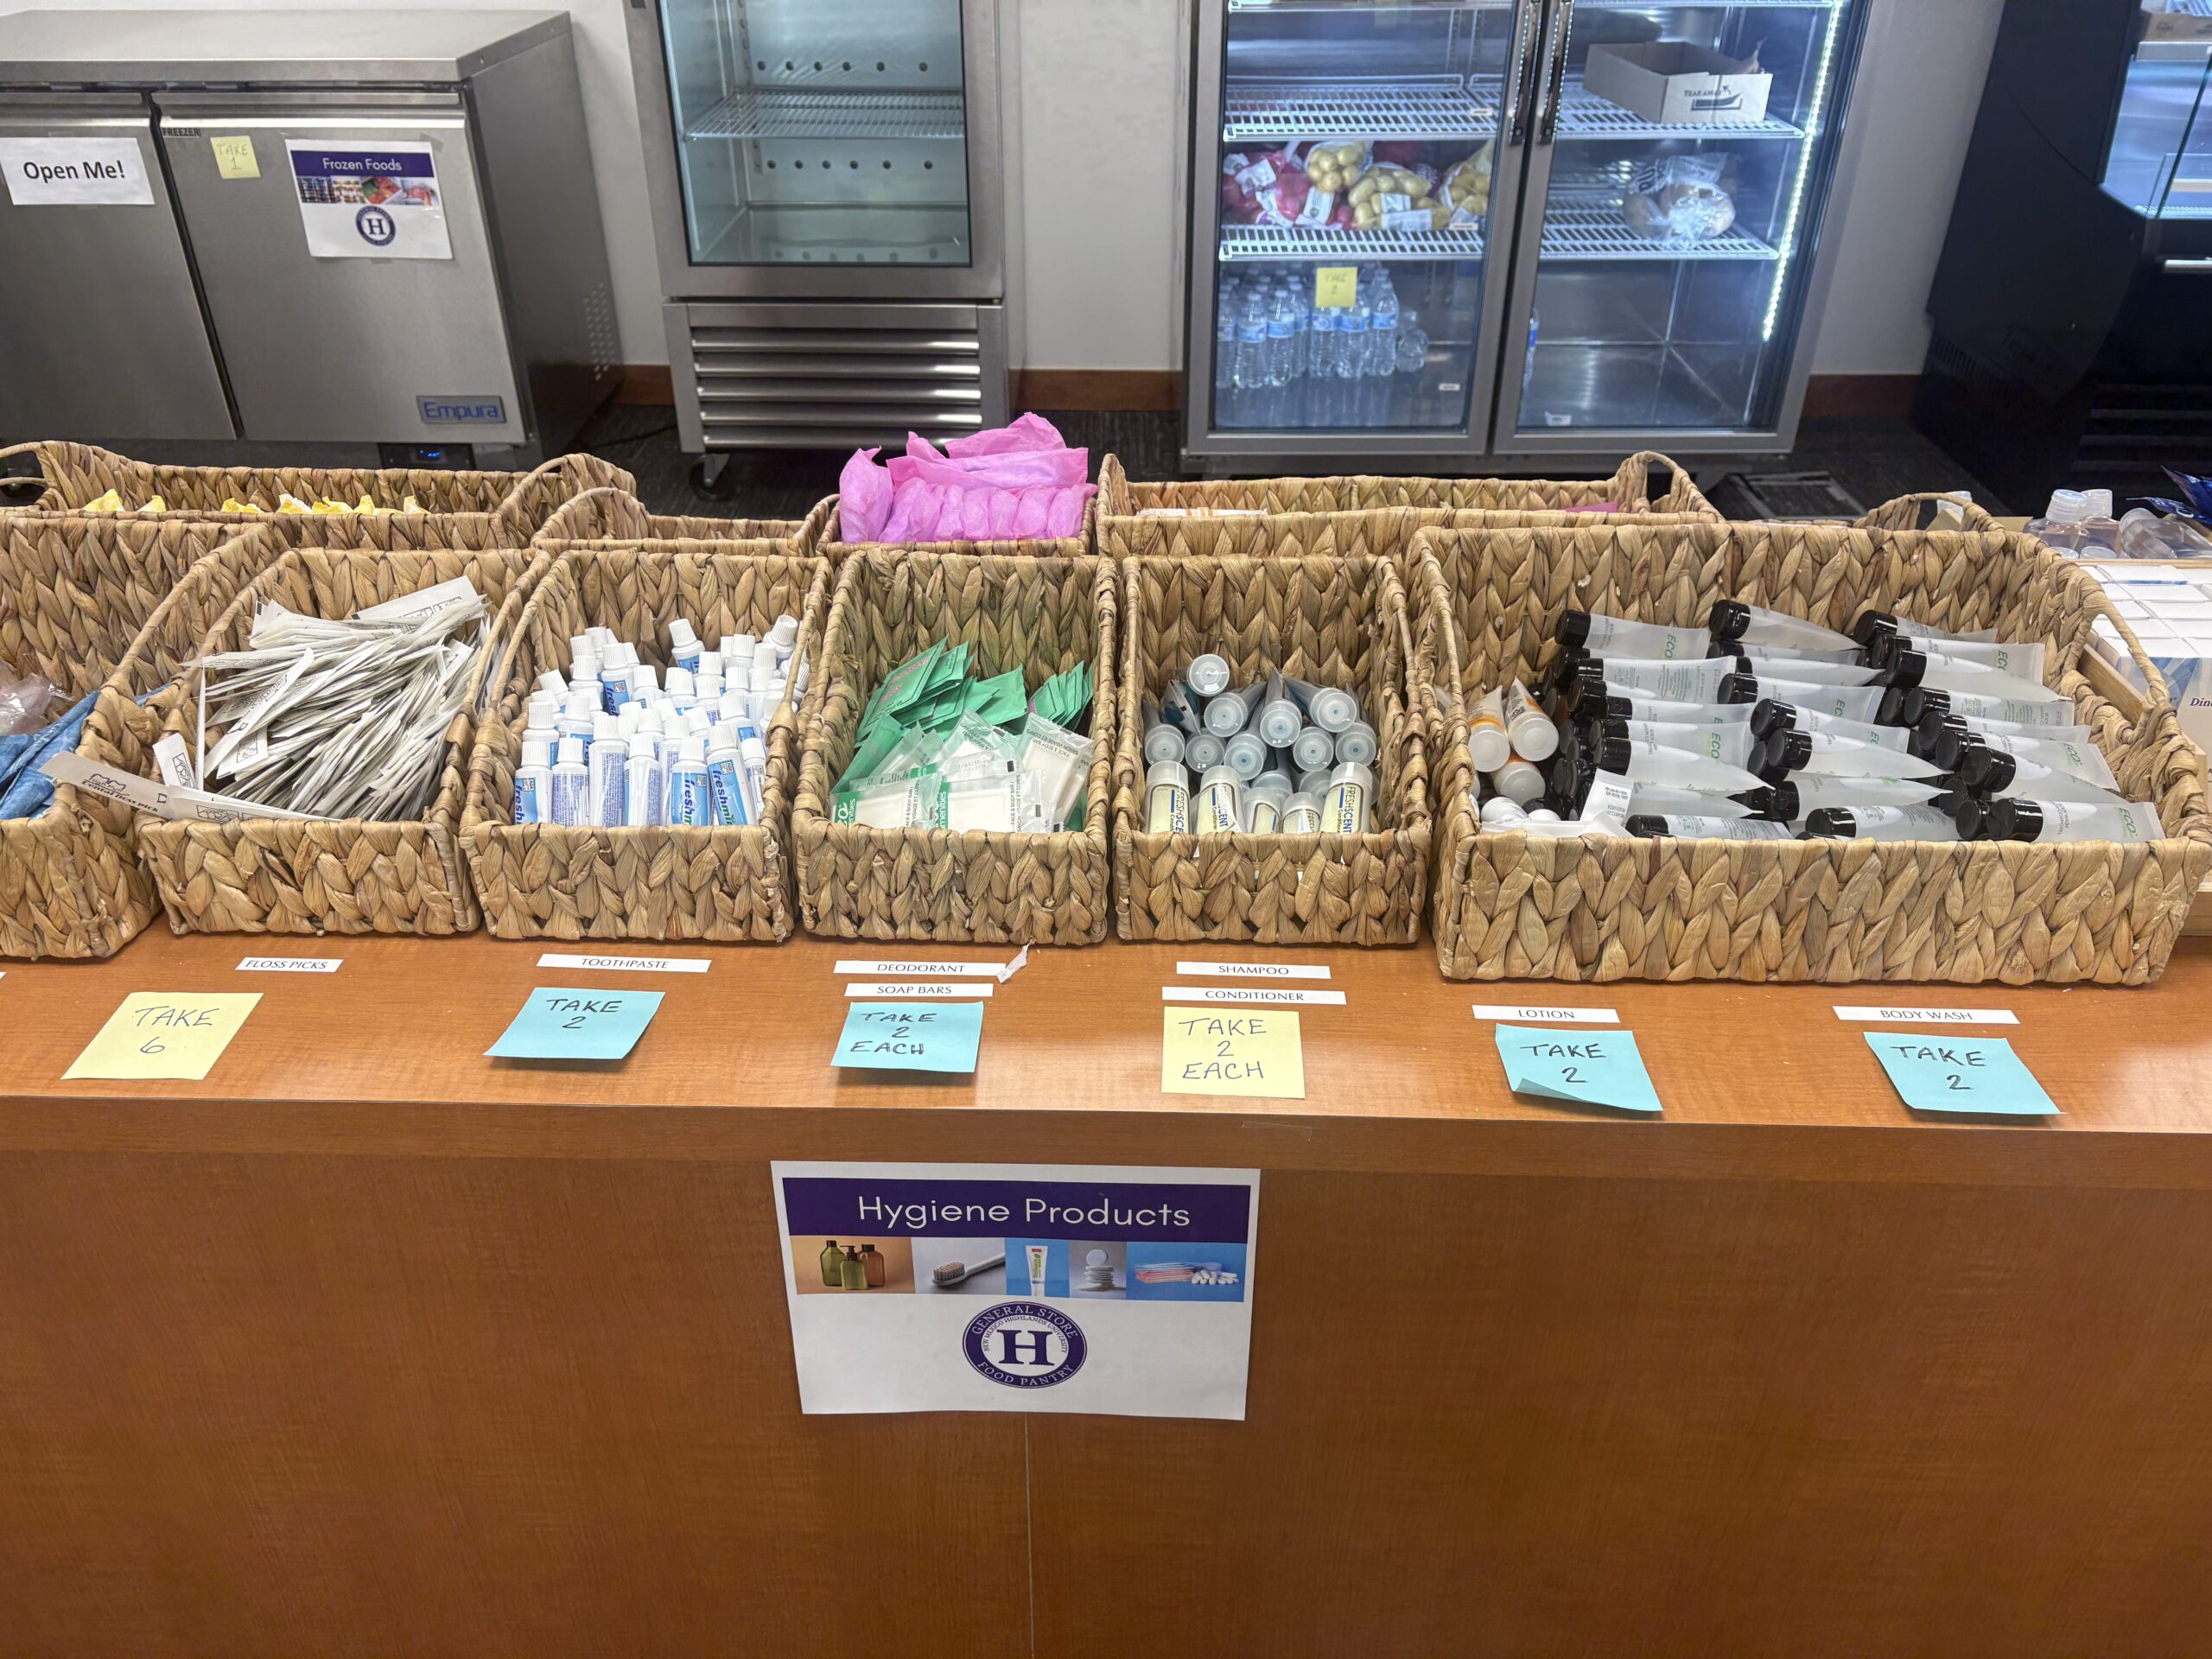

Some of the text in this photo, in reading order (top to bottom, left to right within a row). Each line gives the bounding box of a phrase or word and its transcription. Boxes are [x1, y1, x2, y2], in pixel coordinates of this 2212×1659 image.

[216, 144, 248, 156] TAKE
[23, 160, 125, 183] Open Me!
[231, 157, 242, 170] 1
[322, 157, 403, 171] Frozen Foods
[366, 218, 387, 235] H
[423, 401, 499, 420] Empura
[1834, 699, 1846, 717] EC
[1711, 732, 1721, 760] ECO
[2063, 742, 2082, 764] ECO
[515, 785, 525, 821] fresh
[712, 770, 736, 826] freshmi
[137, 803, 159, 813] pick
[1175, 787, 1185, 833] FRESHSCE
[1343, 786, 1356, 833] FRESHSCENT
[2119, 808, 2137, 836] ECO
[245, 960, 328, 969] FLOSS PICKS
[582, 957, 670, 969] TOOTHPASTE
[877, 963, 965, 973] DEODORANT
[1218, 965, 1289, 976] SHAMPOO
[1205, 990, 1304, 1001] CONDITIONER
[546, 999, 622, 1014] TAKE
[1518, 1009, 1575, 1019] LOTION
[1880, 1010, 1973, 1020] BODY WASH
[135, 1006, 219, 1028] TAKE
[562, 1016, 586, 1029] 2
[860, 1012, 938, 1023] TAKE
[891, 1027, 911, 1039] 2
[1179, 1018, 1267, 1036] TAKE
[139, 1036, 165, 1054] 6
[850, 1040, 925, 1055] EACH
[1217, 1040, 1235, 1057] 2
[1519, 1043, 1606, 1058] TAKE
[1889, 1046, 1987, 1066] TAKE
[1182, 1061, 1264, 1079] EACH
[1561, 1067, 1590, 1084] 2
[1946, 1074, 1974, 1090] 2
[858, 1196, 1190, 1229] Hygiene Products
[971, 1305, 1078, 1338] GENERAL STORE
[985, 1320, 1004, 1340] MEXICO
[1003, 1315, 1047, 1326] HIGHLANDS
[1047, 1323, 1068, 1354] UNIVERSITY
[996, 1329, 1055, 1366] H
[977, 1361, 1074, 1386] FOOD PANTRY
